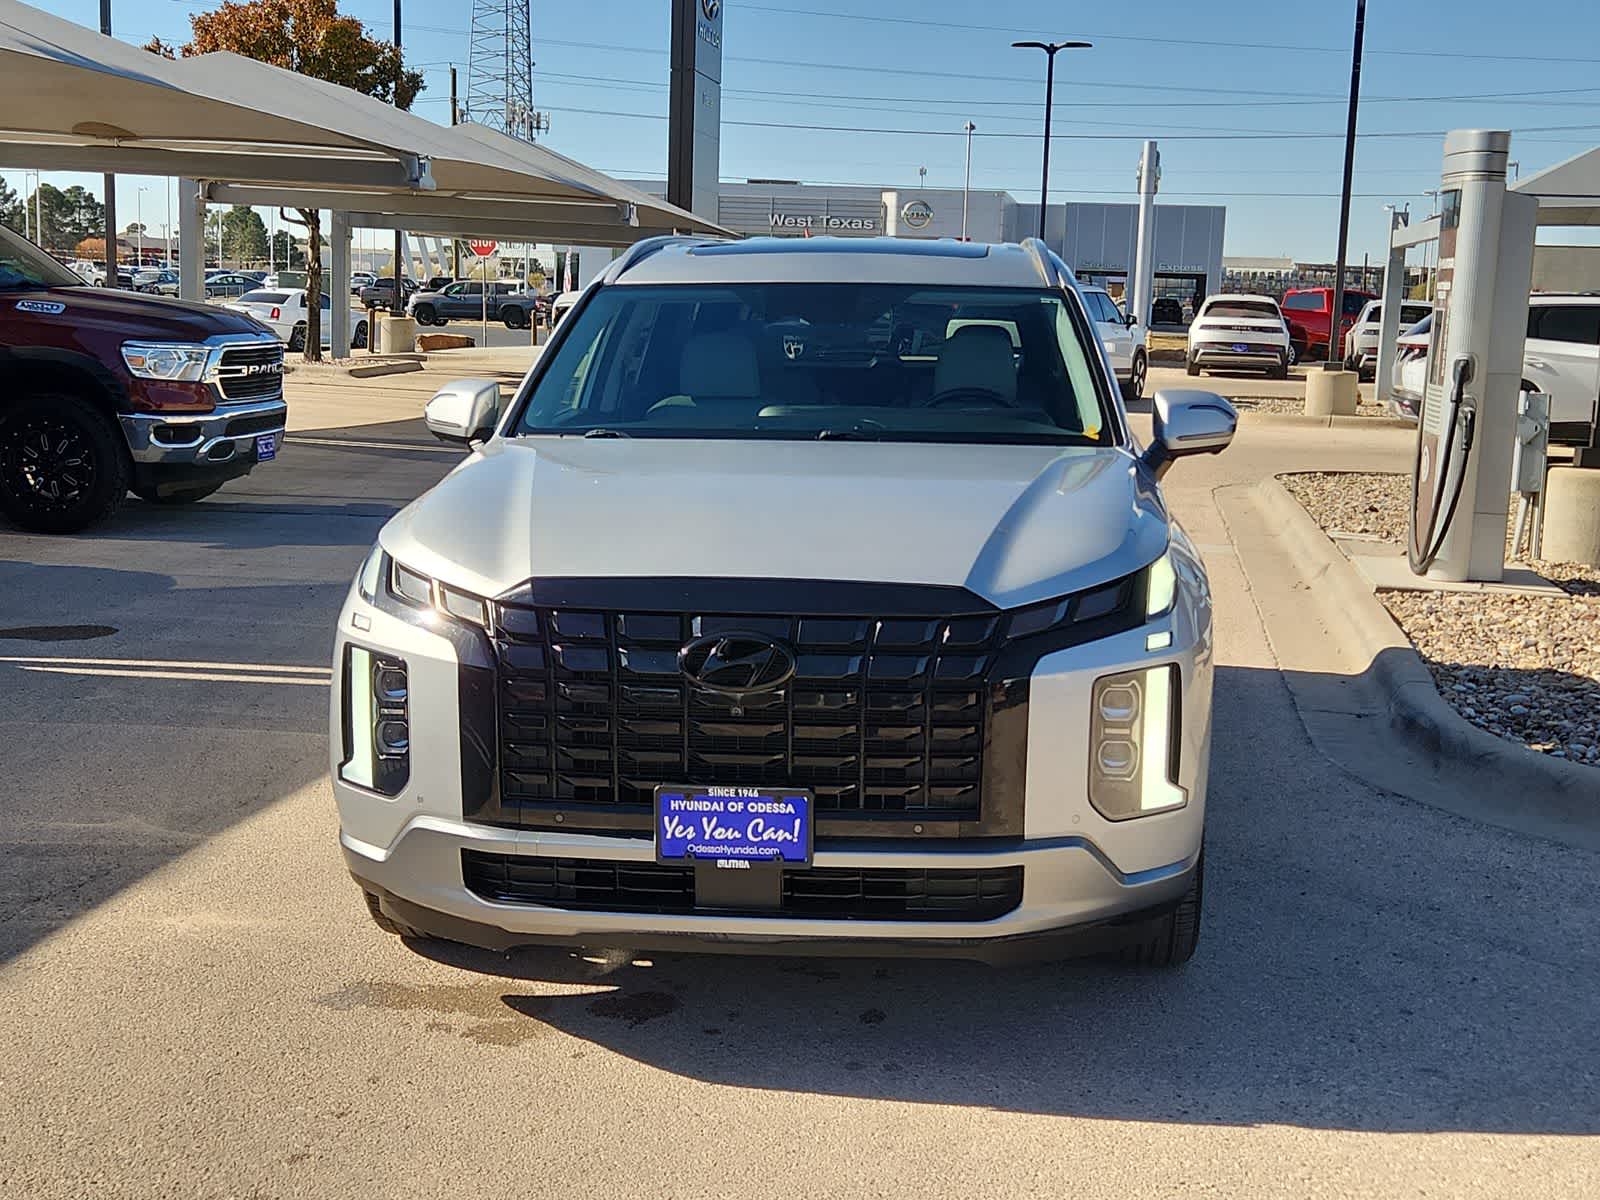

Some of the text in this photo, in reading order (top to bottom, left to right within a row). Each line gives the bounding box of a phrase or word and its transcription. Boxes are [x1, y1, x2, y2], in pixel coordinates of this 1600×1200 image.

[768, 214, 874, 230] West Texas
[471, 239, 493, 247] STOP
[708, 787, 736, 798] SINCE
[670, 799, 796, 814] HYUNDAI OF ODESSA
[663, 815, 801, 842] Yes You Can!
[687, 843, 780, 856] OdessaHyundai.com
